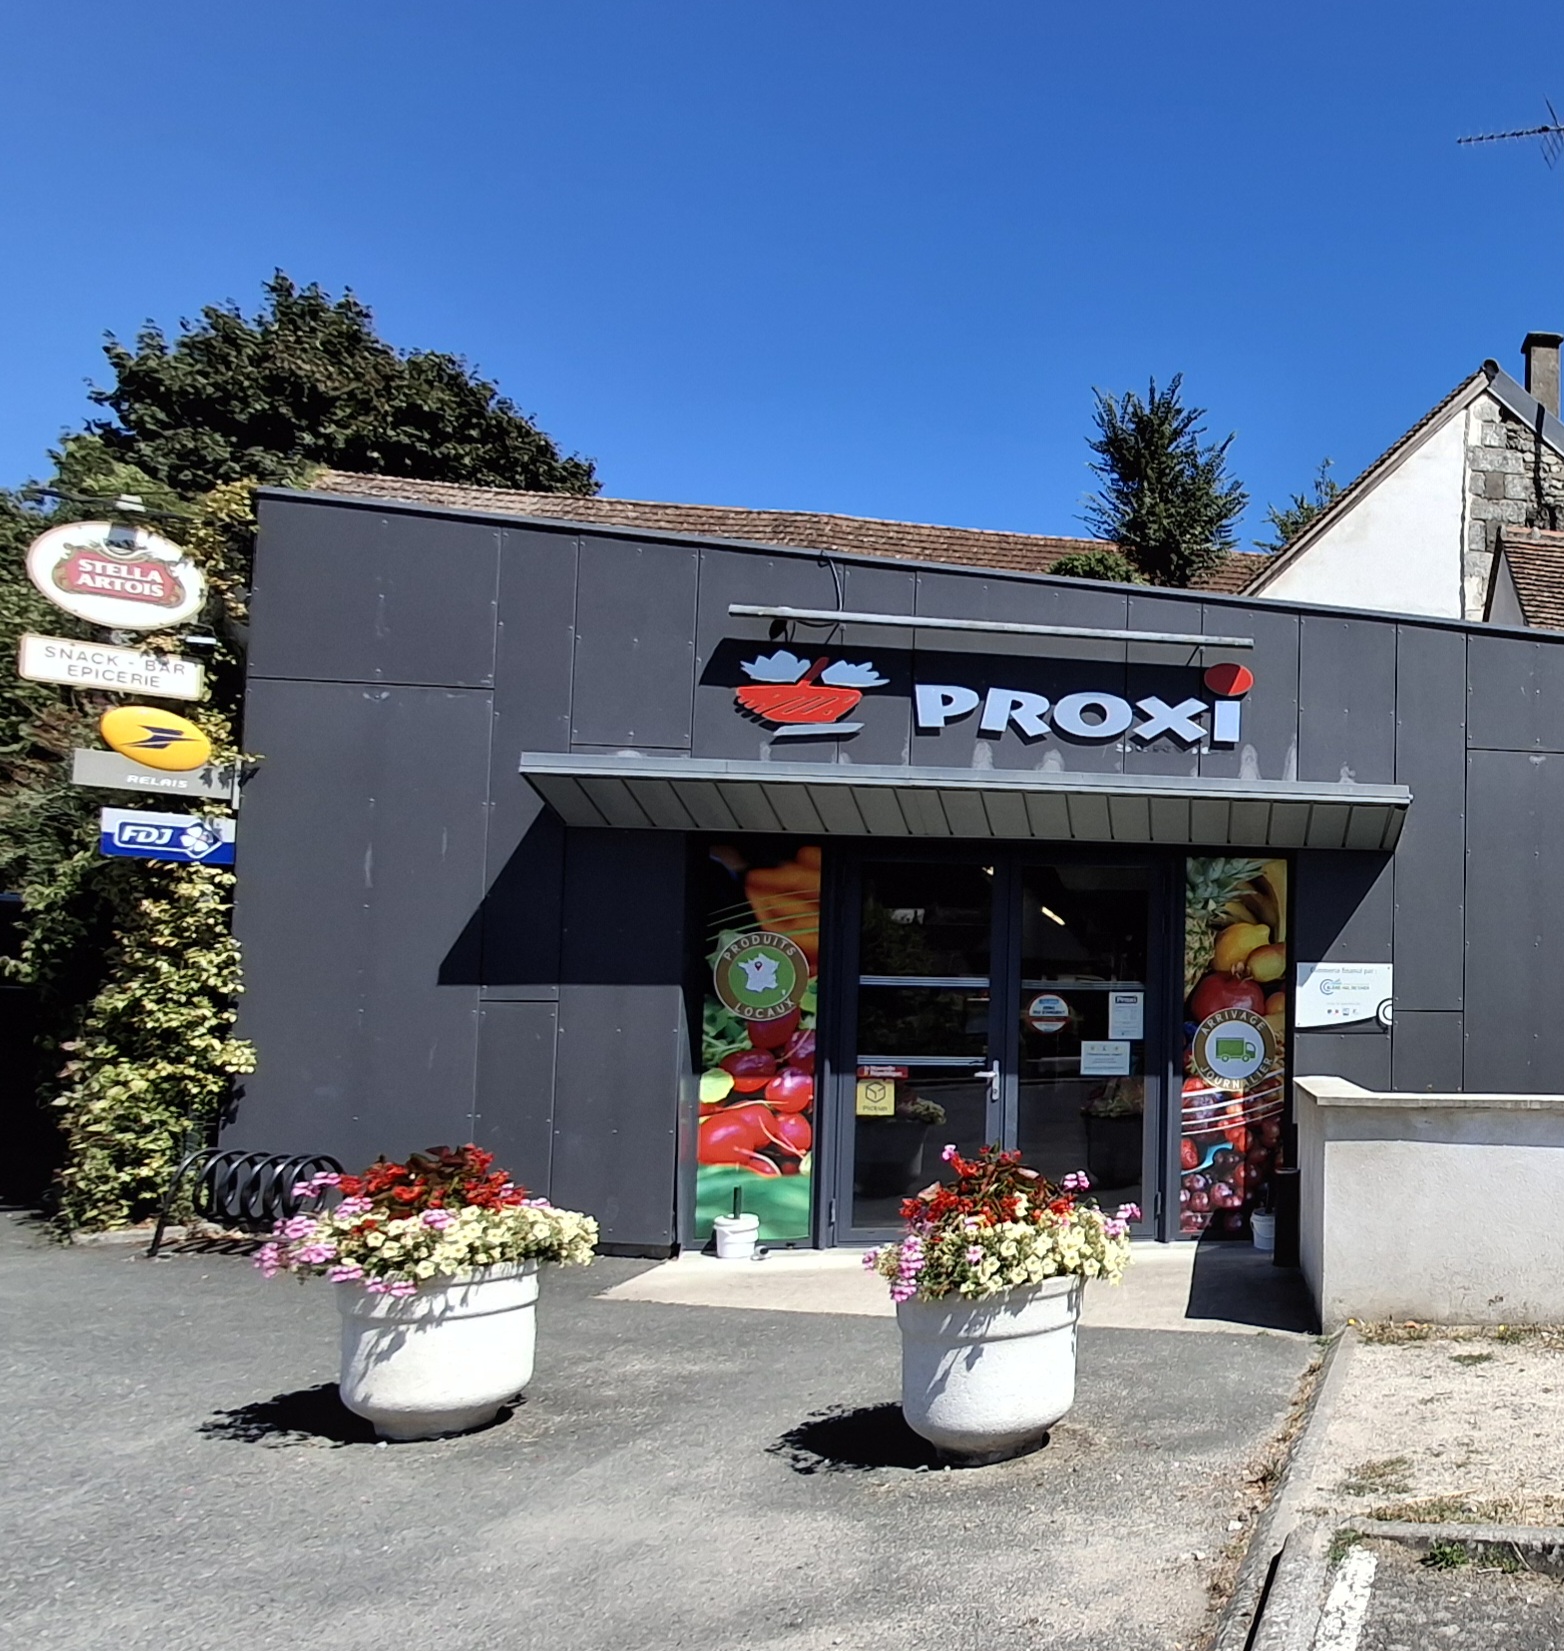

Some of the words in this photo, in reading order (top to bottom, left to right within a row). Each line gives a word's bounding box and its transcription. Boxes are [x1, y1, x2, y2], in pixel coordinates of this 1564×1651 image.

[78, 559, 164, 583] STELLA
[76, 574, 165, 597] ARTOIS
[44, 645, 120, 667] SNACK
[145, 659, 186, 675] BAR
[67, 664, 161, 688] EPICERIE
[126, 774, 189, 789] RELAIS
[120, 825, 174, 845] FDJ
[723, 934, 797, 961] PRODUITS
[734, 998, 795, 1018] LOCAUX
[1201, 1010, 1266, 1036] ARRIVAGE
[1200, 1057, 1273, 1089] JOURNALIER
